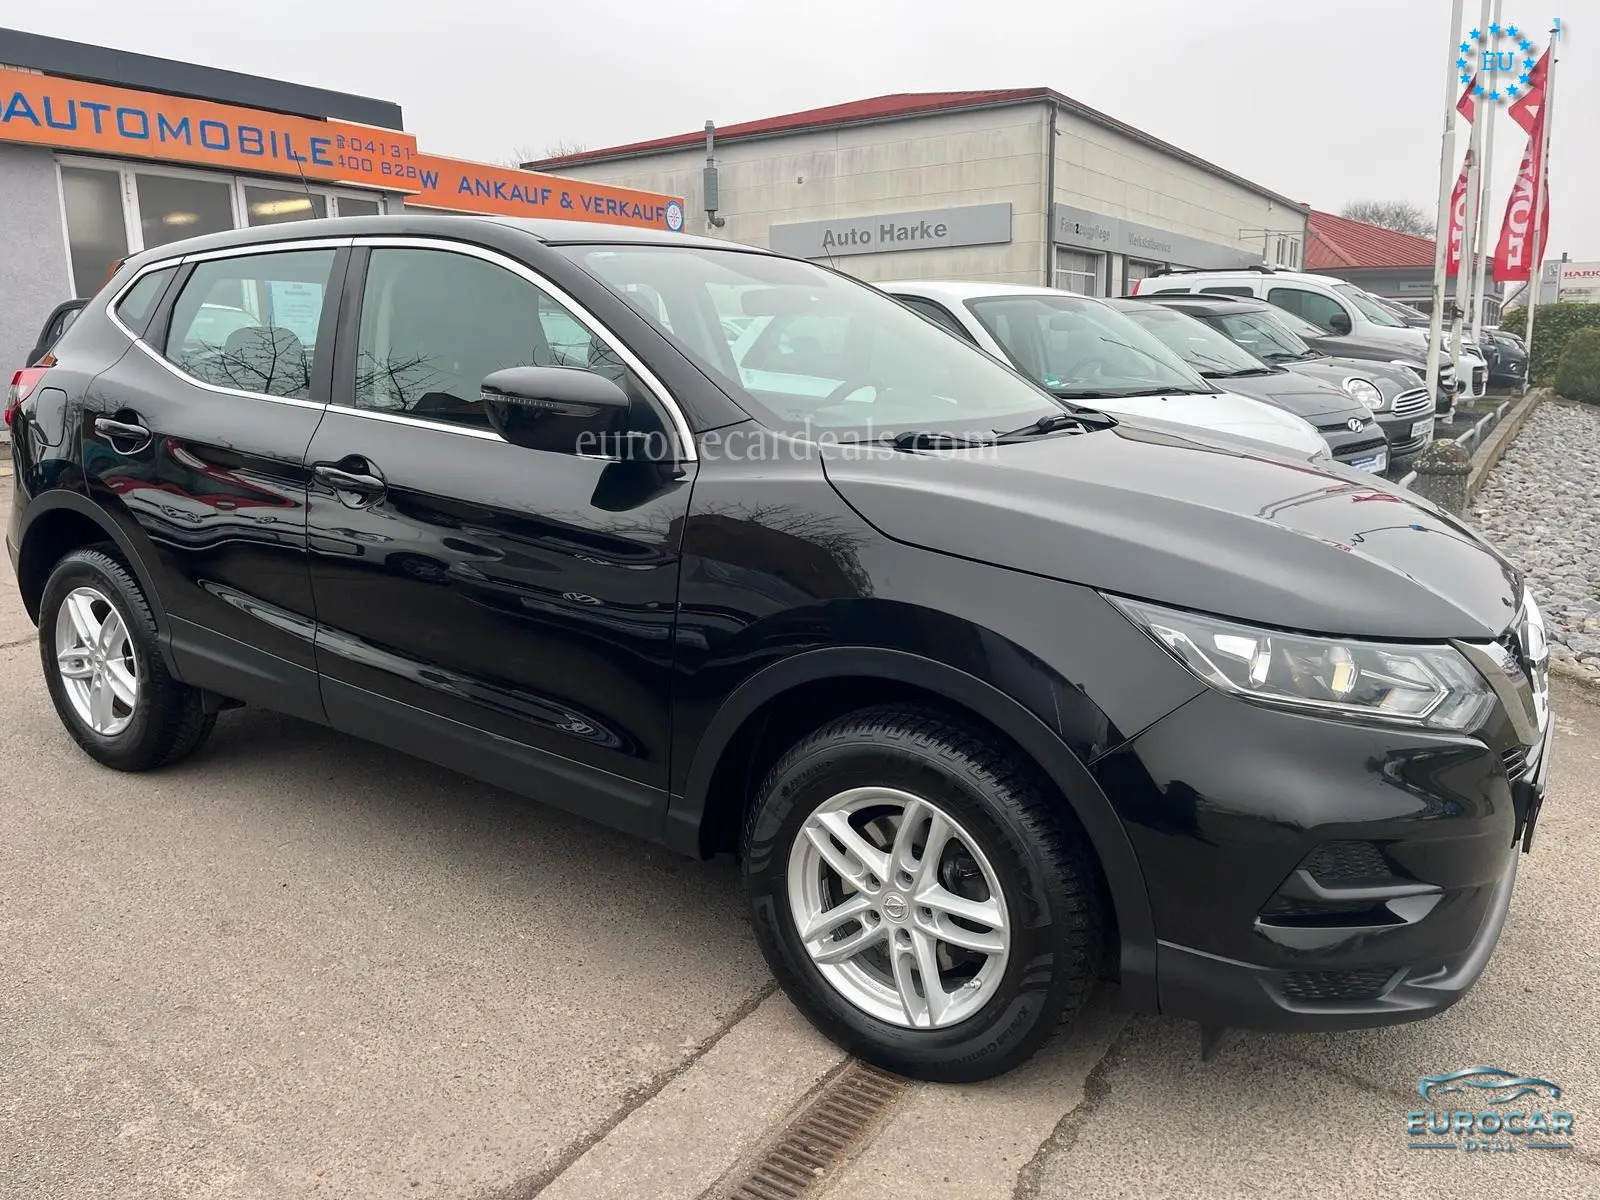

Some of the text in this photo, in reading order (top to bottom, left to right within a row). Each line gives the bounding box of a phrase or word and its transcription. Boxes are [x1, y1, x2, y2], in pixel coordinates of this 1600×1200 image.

[458, 175, 552, 206] ANKAUF
[560, 191, 574, 210] &
[580, 194, 665, 223] VERKAUF
[822, 220, 948, 248] Auto Harke
